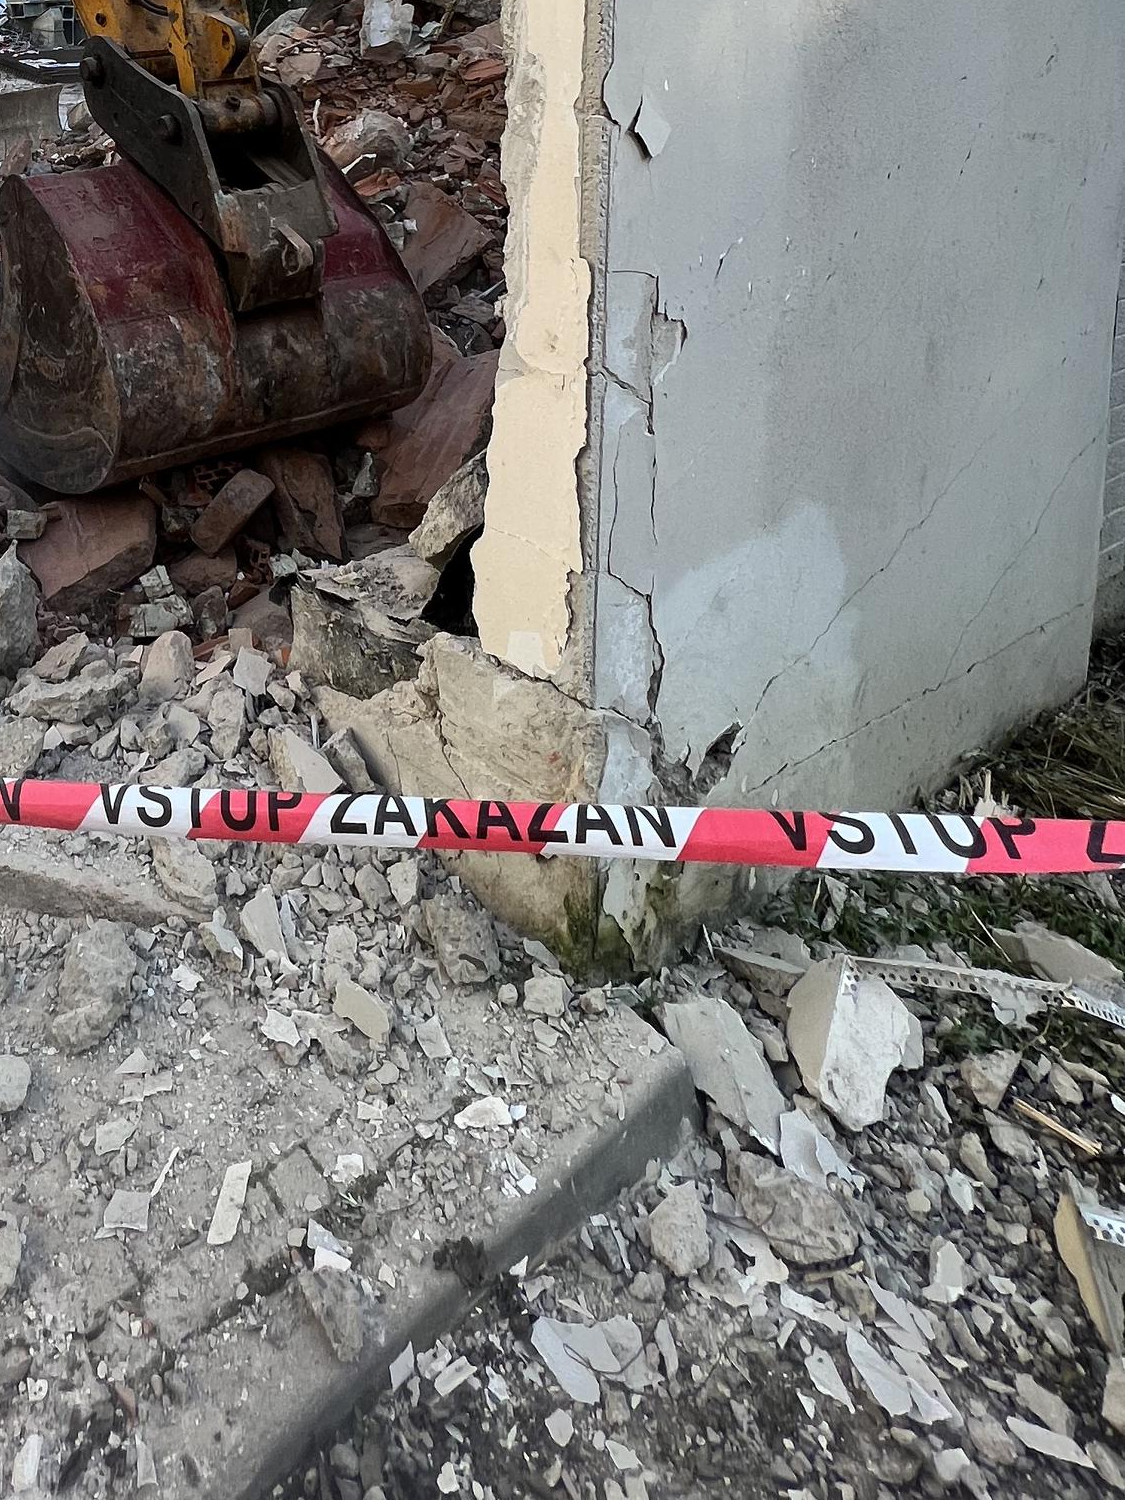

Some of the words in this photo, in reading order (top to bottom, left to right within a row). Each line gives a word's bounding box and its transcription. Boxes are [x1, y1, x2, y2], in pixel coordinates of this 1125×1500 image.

[100, 783, 303, 832] VSTUP
[330, 793, 678, 849] ZAKAZAN
[768, 811, 1036, 860] VSTUP
